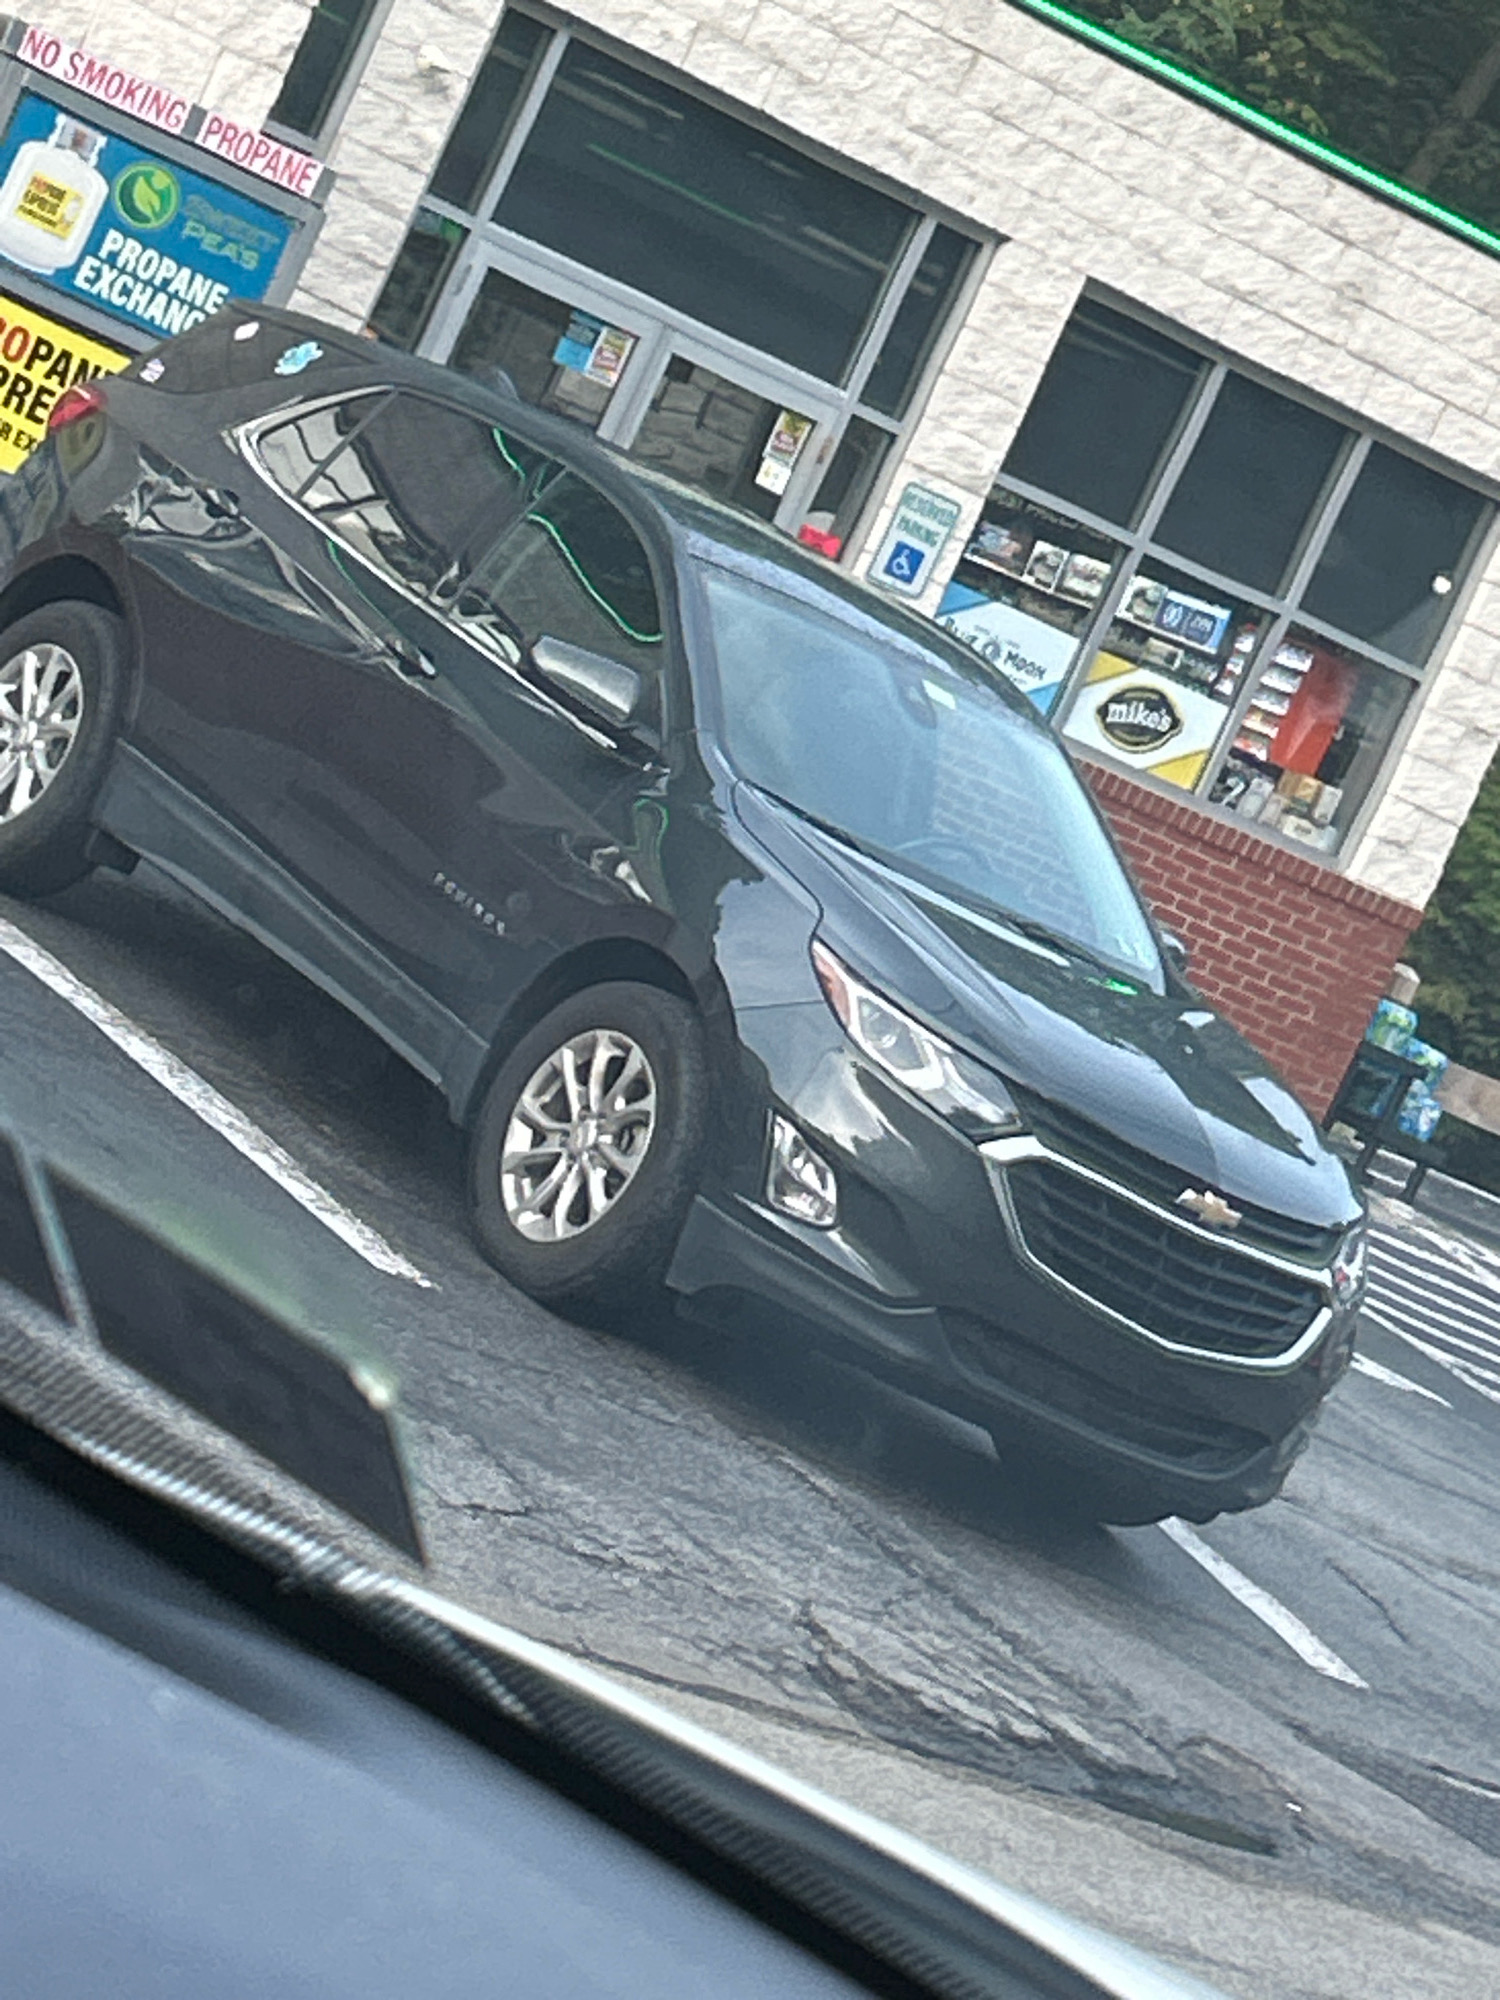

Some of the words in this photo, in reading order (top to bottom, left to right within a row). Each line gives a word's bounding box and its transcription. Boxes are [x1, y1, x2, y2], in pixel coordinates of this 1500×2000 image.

[23, 29, 61, 69] NO
[63, 51, 187, 128] SMOKING
[201, 116, 318, 193] PROPANE
[98, 228, 230, 315] PROPANE
[1105, 700, 1172, 733] mike's
